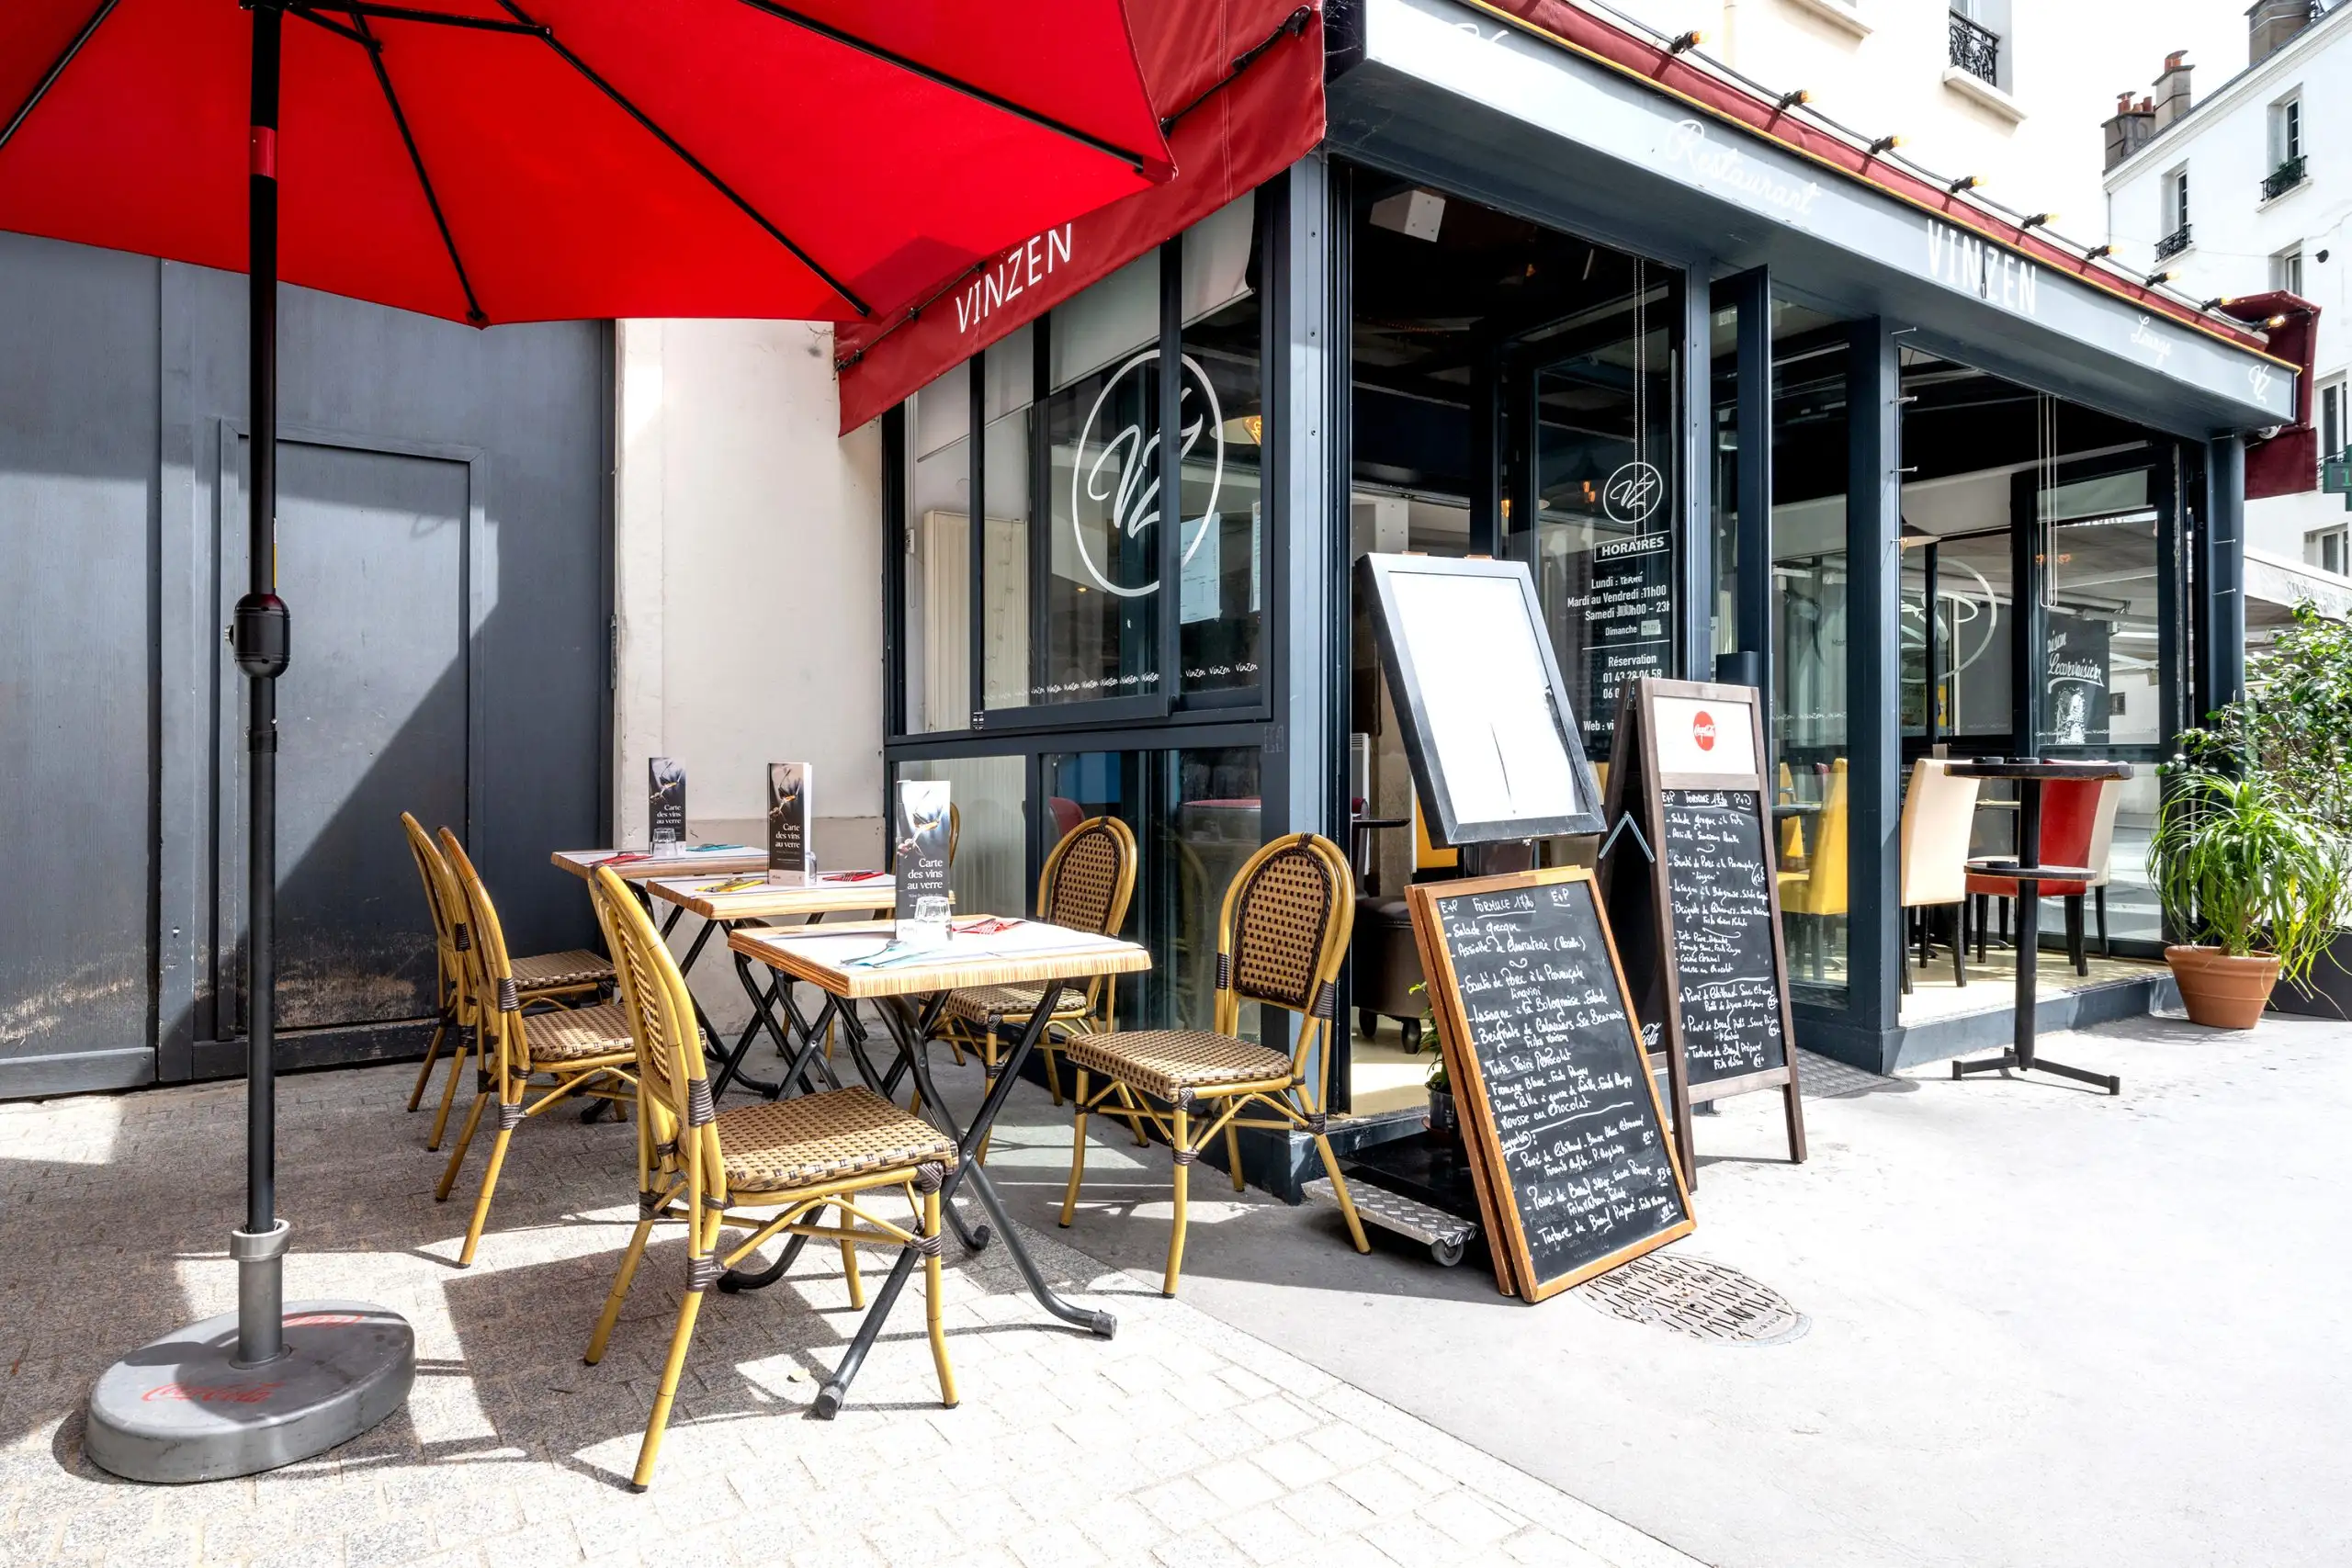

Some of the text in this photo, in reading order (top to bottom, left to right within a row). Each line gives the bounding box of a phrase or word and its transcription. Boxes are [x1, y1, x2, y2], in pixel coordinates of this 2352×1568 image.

[1665, 119, 1821, 215] Restaurant
[1928, 219, 2036, 316] VINZEN
[956, 223, 1071, 333] VINZEN
[2130, 315, 2172, 368] Lounge
[1601, 536, 1665, 557] HORAIRES
[1591, 577, 1613, 589] Lundi
[1567, 595, 1589, 608] Mardi
[1590, 596, 1601, 605] au
[1602, 589, 1639, 604] Vendredi
[1585, 608, 1614, 621] Samedi
[1605, 625, 1637, 636] Dimanche
[1608, 654, 1657, 668] Réservation
[1602, 673, 1612, 683] 01
[1602, 688, 1612, 699] 06
[1583, 720, 1600, 731] Web
[783, 823, 800, 831] Carte
[775, 831, 800, 840] des vins
[785, 840, 800, 849] verre
[919, 858, 944, 868] Carte
[908, 869, 944, 879] des vins
[907, 880, 944, 890] au verre
[1473, 897, 1510, 913] FORMULE
[1453, 921, 1480, 937] Salade
[1464, 972, 1491, 994] Sauté
[1493, 976, 1503, 988] de
[1548, 1094, 1591, 1117] Chocolat
